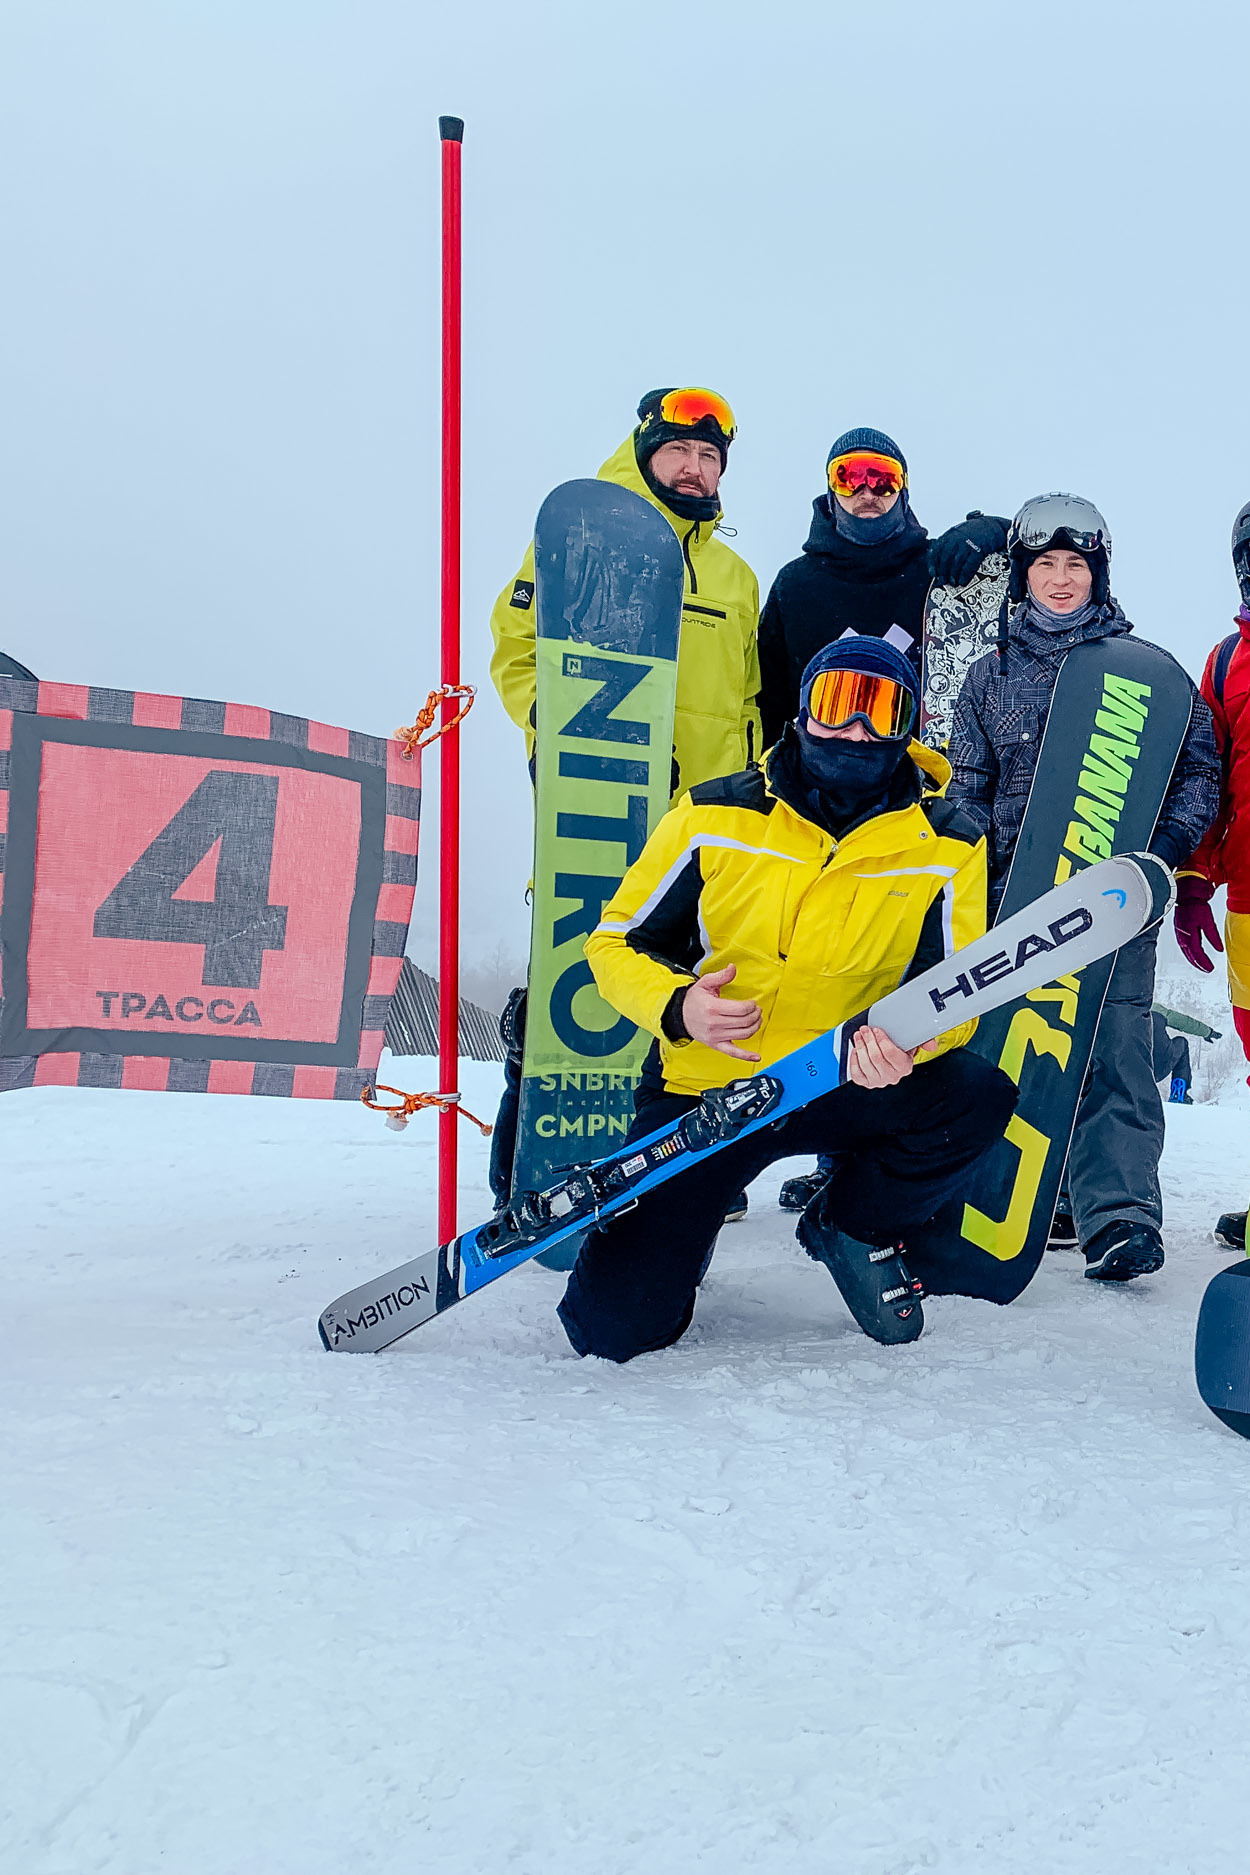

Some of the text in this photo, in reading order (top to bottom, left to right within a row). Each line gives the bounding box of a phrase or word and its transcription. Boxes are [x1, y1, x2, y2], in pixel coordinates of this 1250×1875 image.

[681, 617, 716, 629] OUNTRIDE
[1064, 672, 1152, 866] BANANA
[92, 770, 289, 990] 4
[549, 652, 655, 1058] NITRO
[928, 907, 1093, 1012] HEAD
[95, 990, 263, 1028] ТРАССА
[805, 1060, 818, 1077] 160
[535, 1113, 637, 1138] CMPN
[334, 1276, 430, 1345] AMBITION
